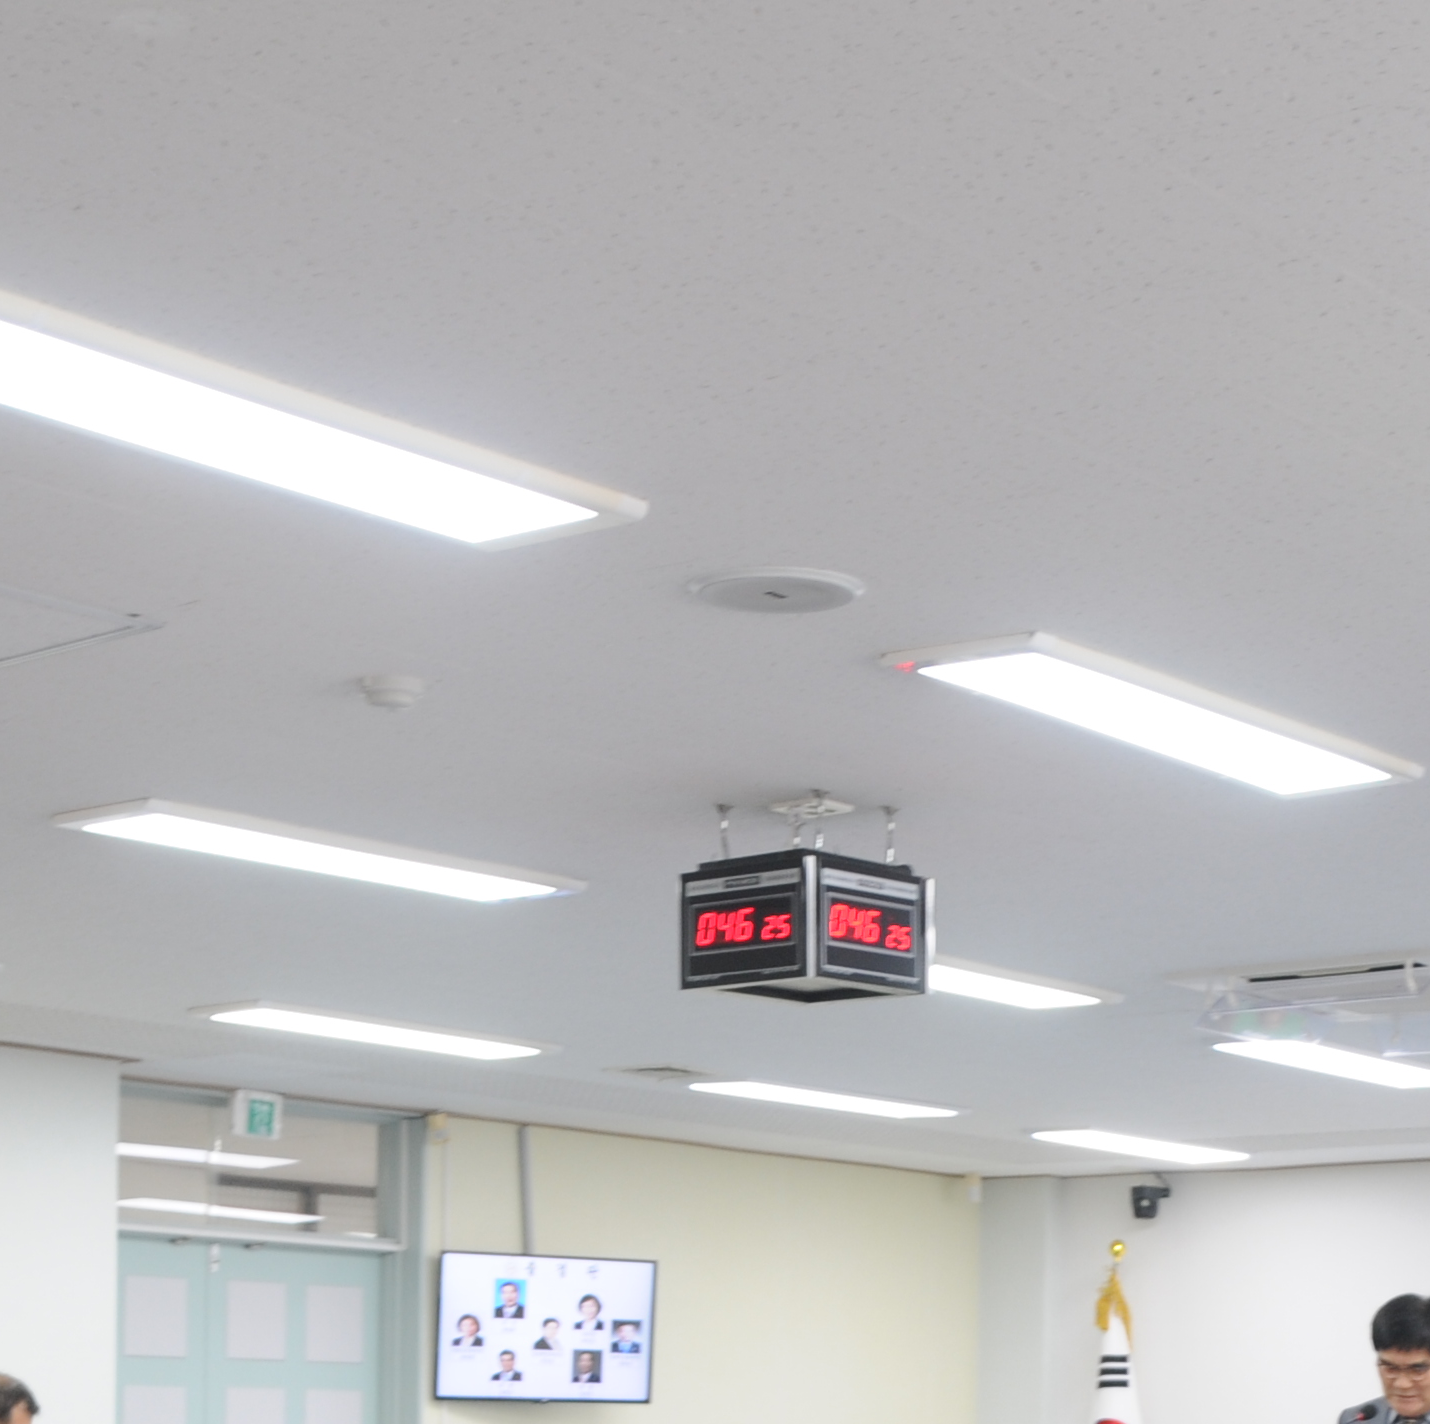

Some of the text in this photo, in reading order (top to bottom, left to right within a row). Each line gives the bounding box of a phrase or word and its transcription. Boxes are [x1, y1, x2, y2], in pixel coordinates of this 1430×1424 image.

[695, 907, 792, 947] 046 25
[828, 903, 912, 951] 046 25
